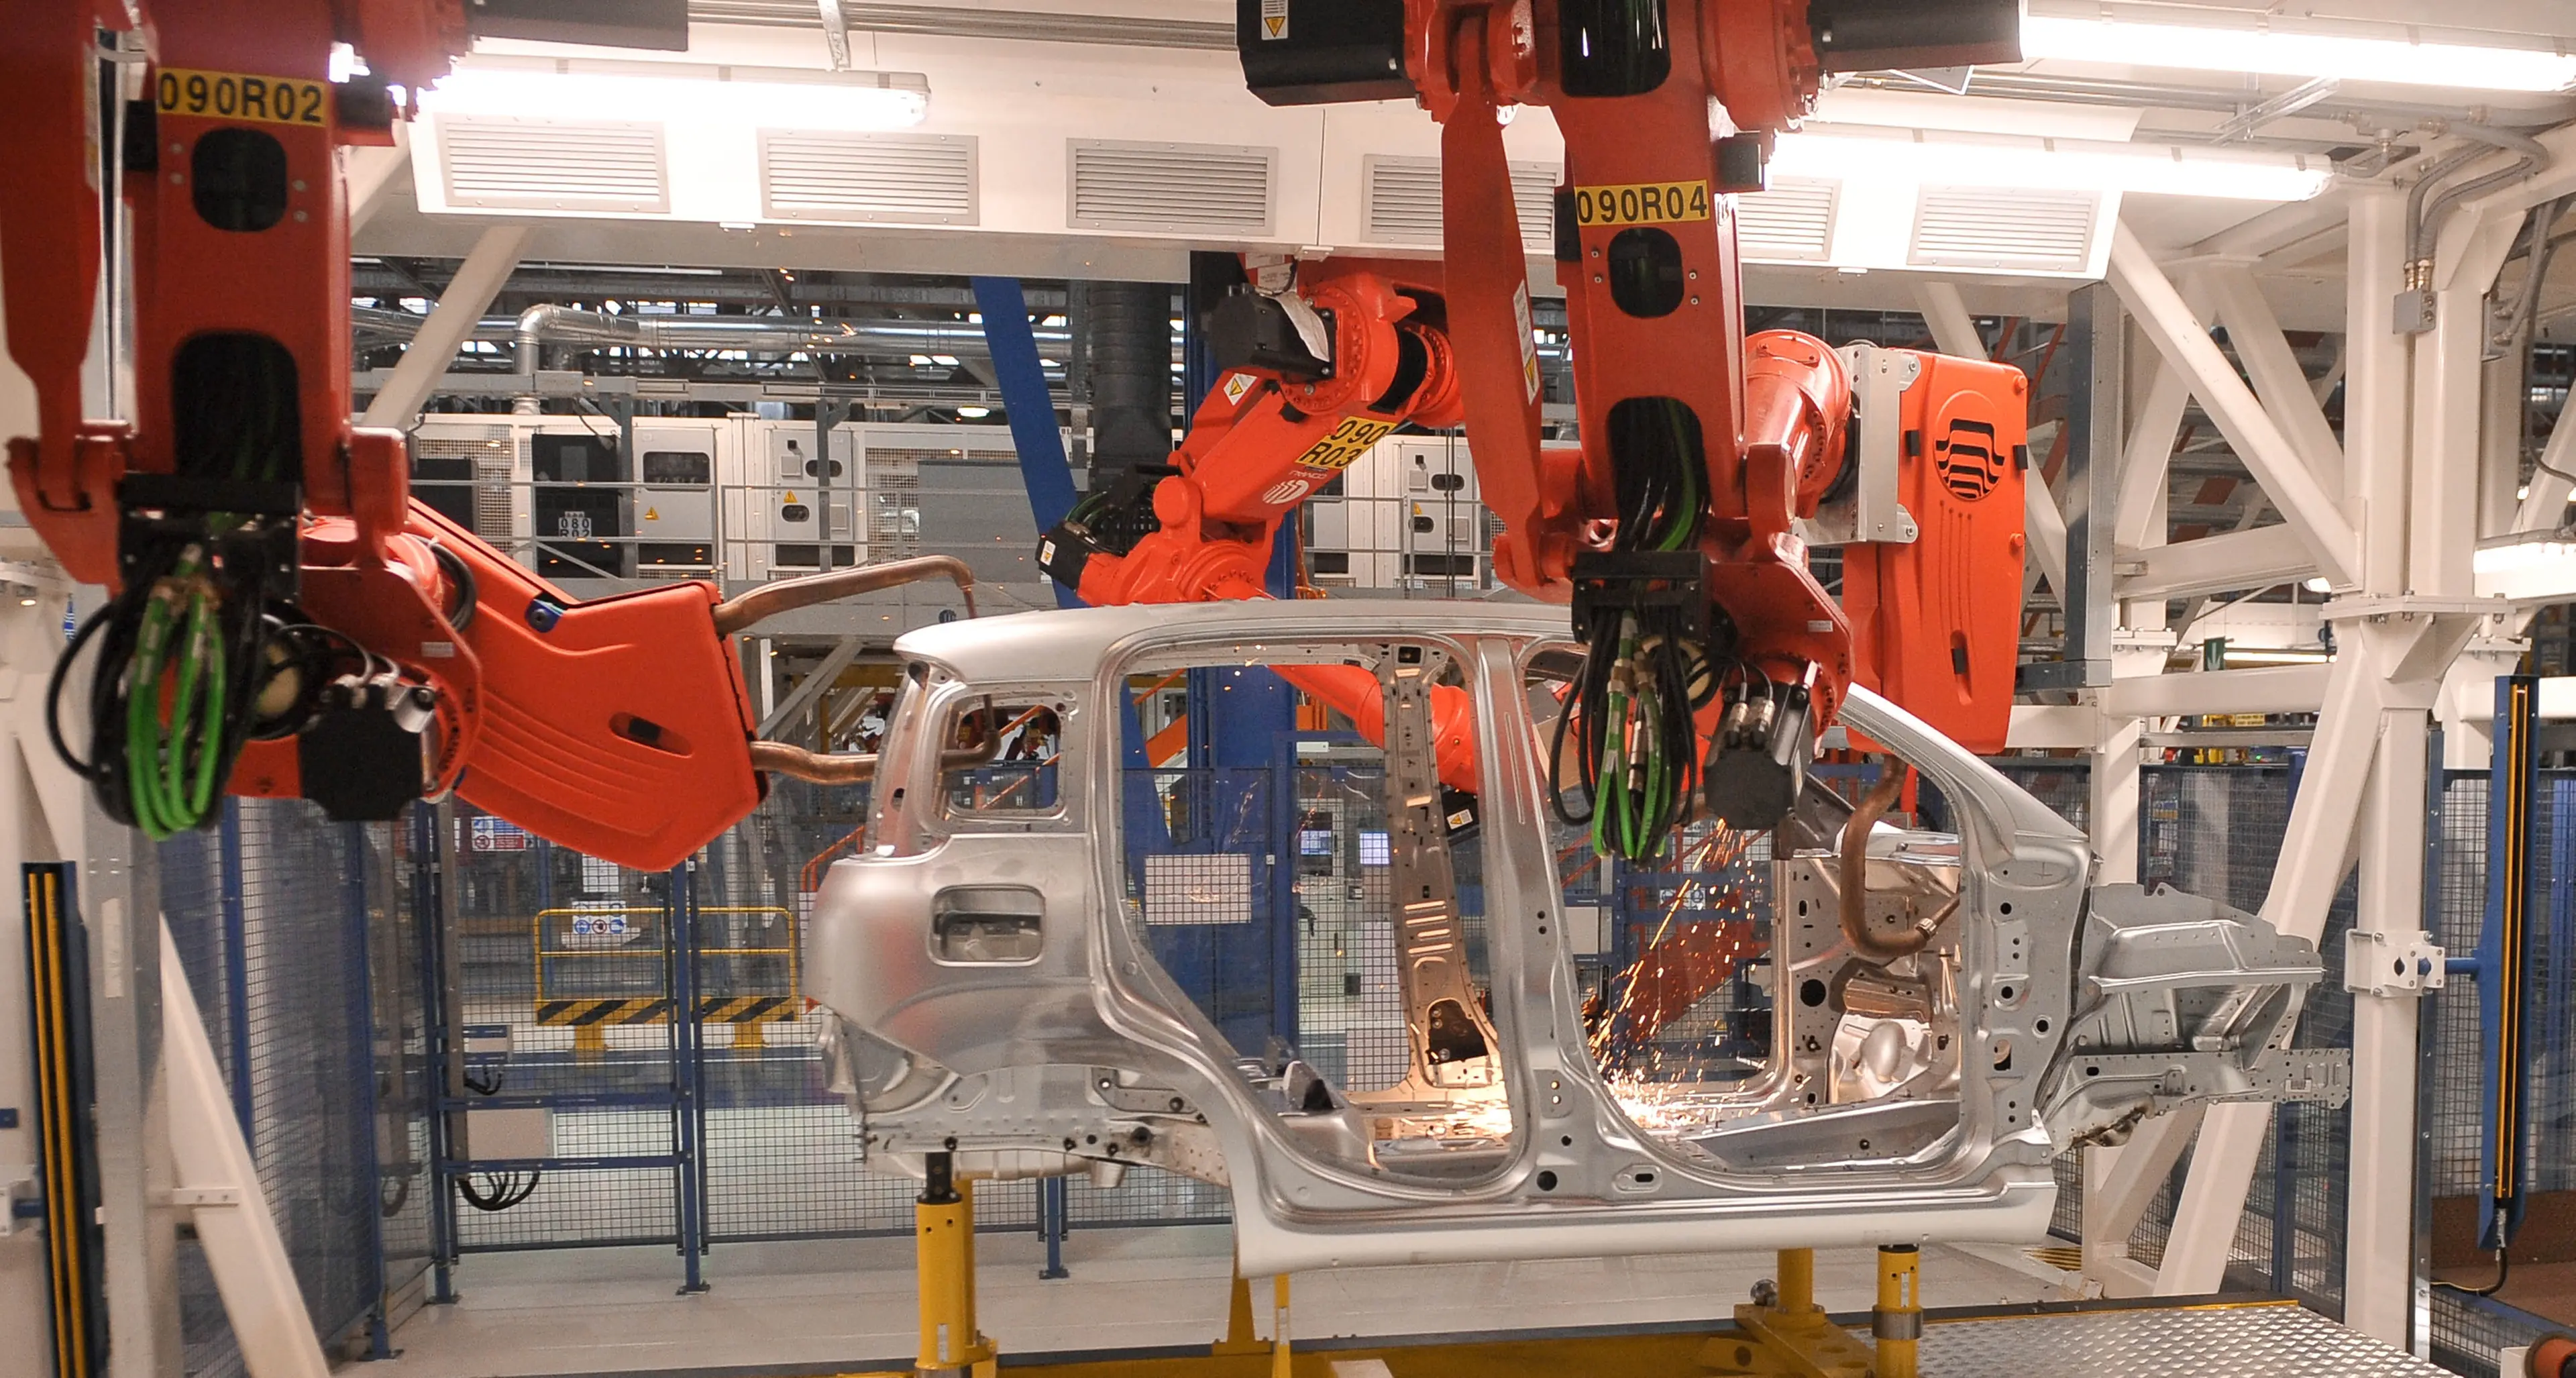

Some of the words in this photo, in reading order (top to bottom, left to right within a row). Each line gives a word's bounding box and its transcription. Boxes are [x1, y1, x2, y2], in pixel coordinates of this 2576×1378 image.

[160, 72, 321, 122] 090R02
[1576, 186, 1707, 223] 090R04
[1330, 420, 1389, 445] 090
[1299, 441, 1362, 467] R03
[561, 518, 590, 528] 080
